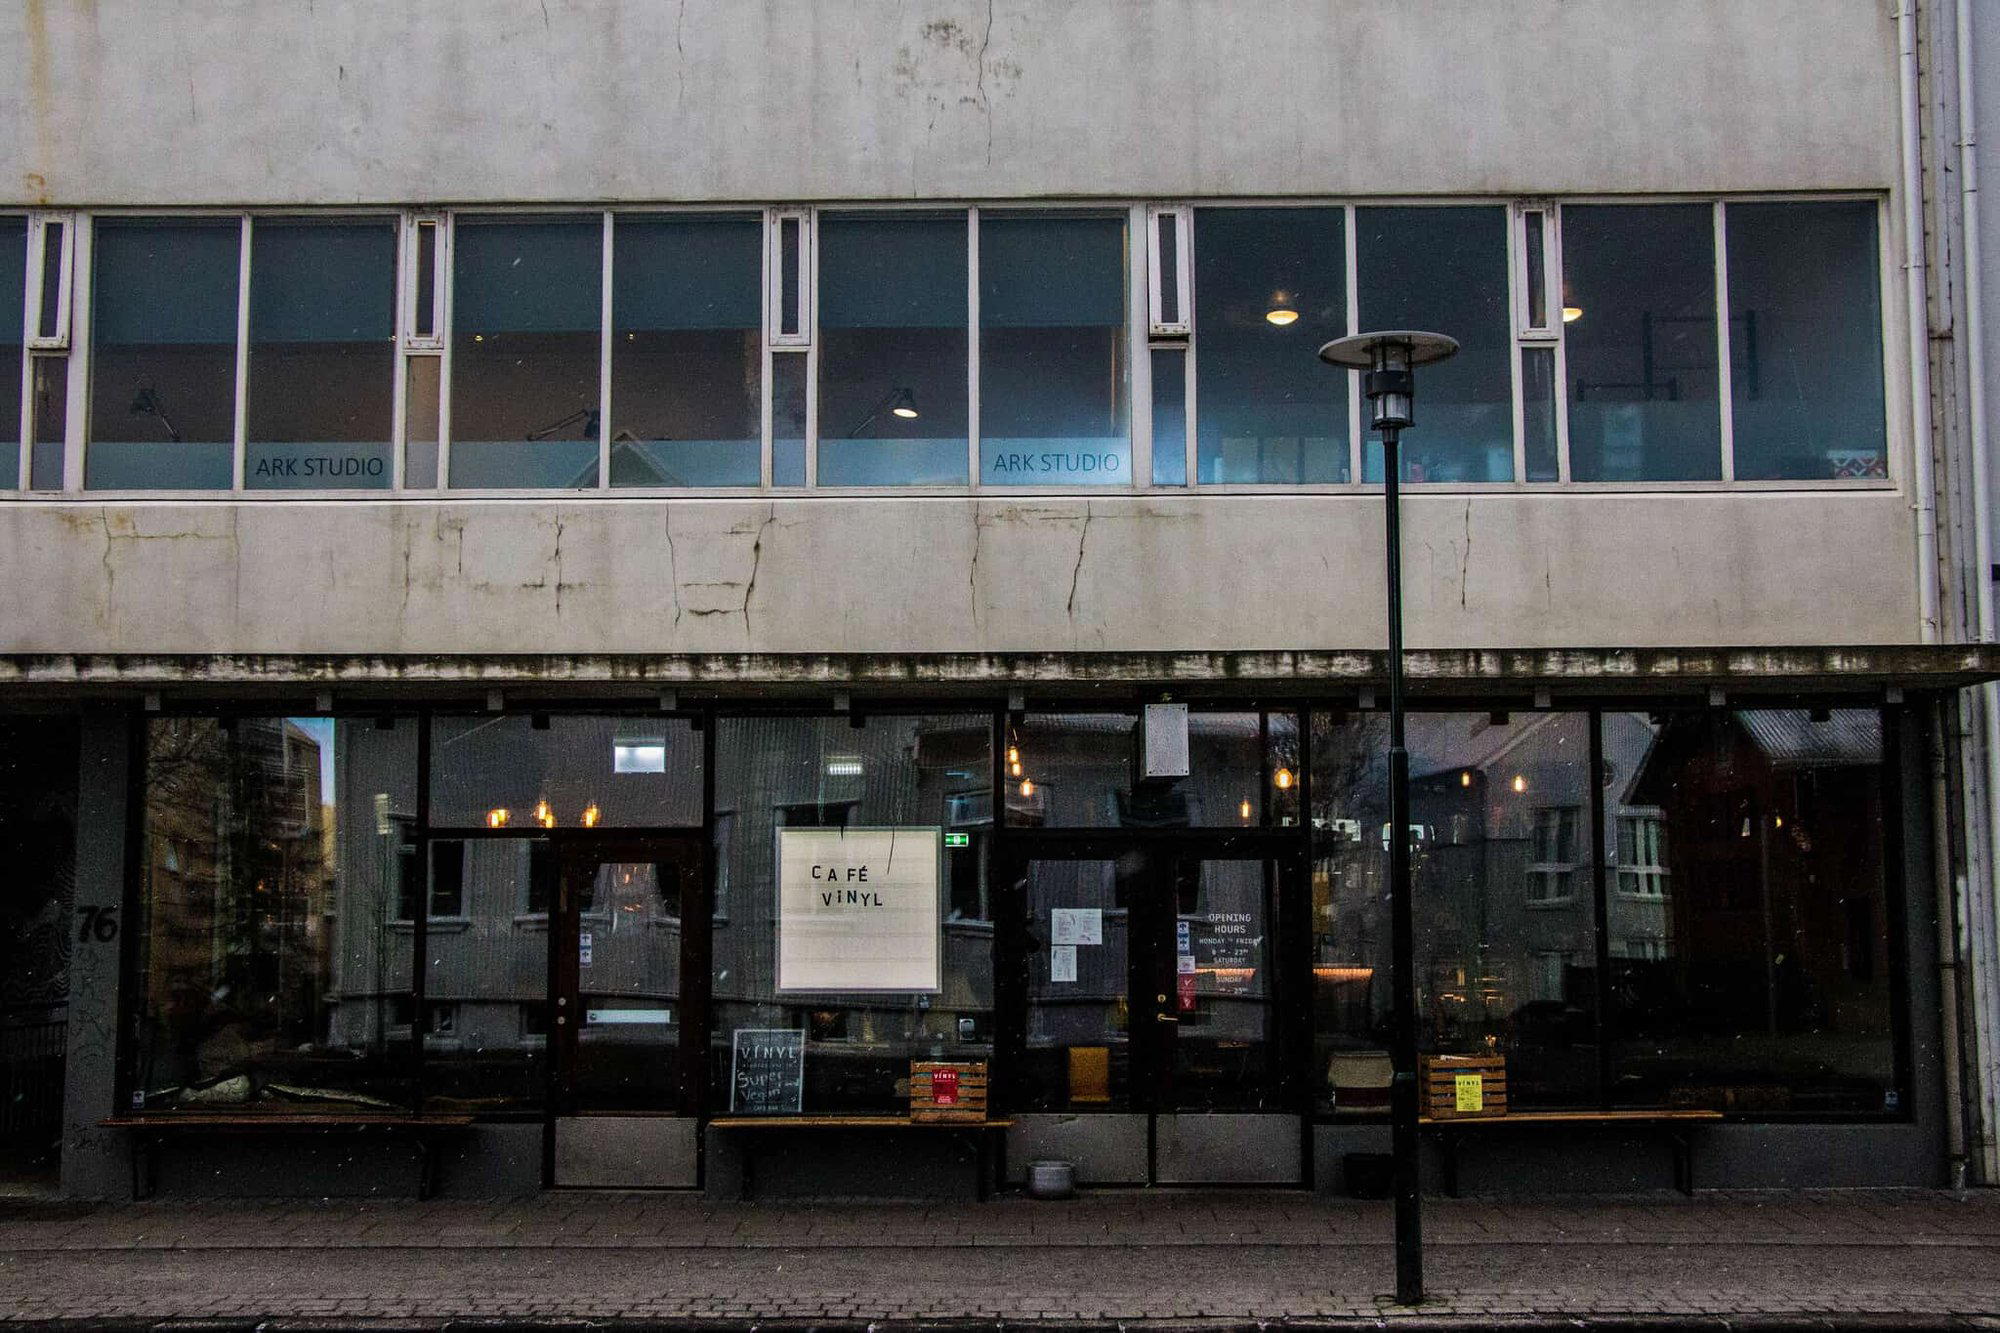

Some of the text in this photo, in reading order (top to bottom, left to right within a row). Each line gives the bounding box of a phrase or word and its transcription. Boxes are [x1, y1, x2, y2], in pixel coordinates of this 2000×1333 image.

[256, 457, 383, 476] ARK STUDIO
[993, 453, 1119, 471] ARK STUDIO
[812, 865, 867, 882] CAFÉ
[77, 905, 118, 942] 76
[1209, 913, 1252, 922] OPENING
[1214, 925, 1247, 934] HOURS
